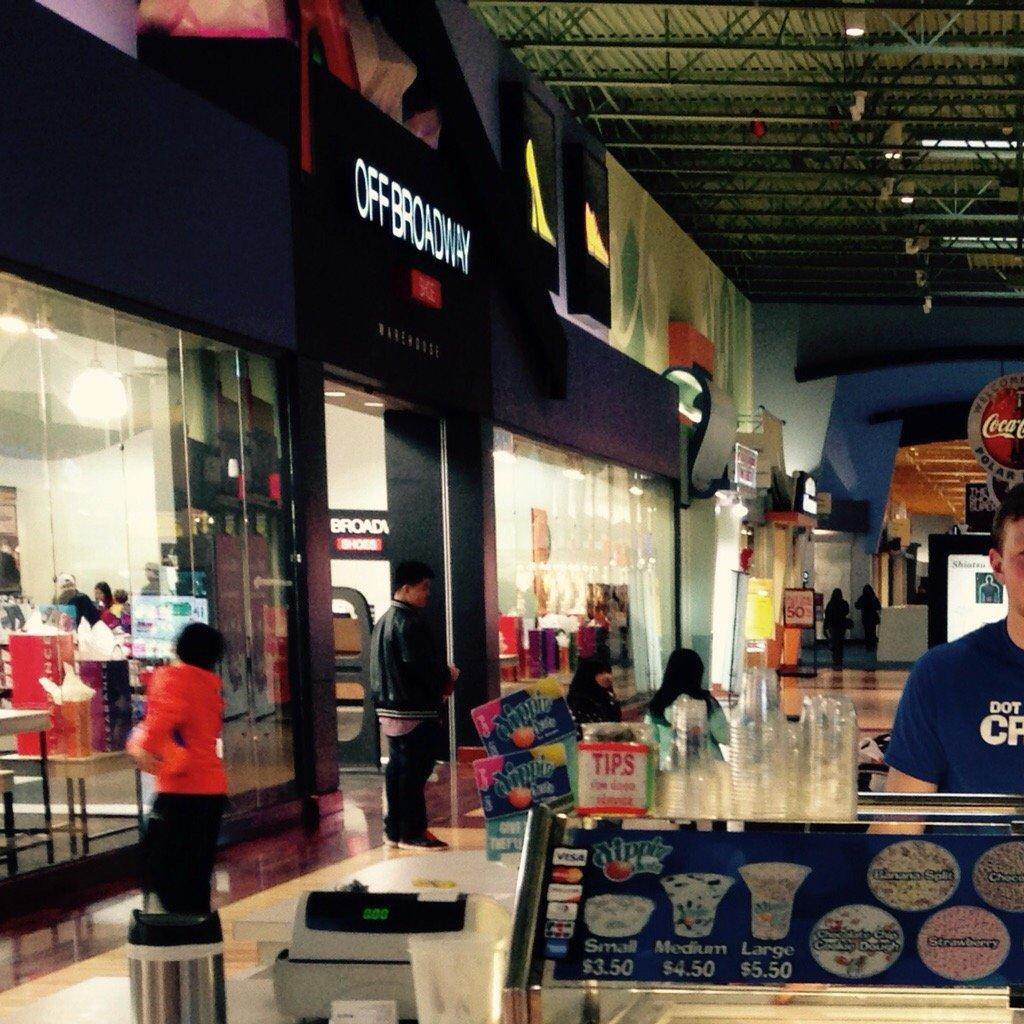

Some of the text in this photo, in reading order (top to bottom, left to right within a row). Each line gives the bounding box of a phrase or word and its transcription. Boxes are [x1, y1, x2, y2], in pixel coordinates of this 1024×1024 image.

[355, 158, 471, 275] OFF BROADWAY
[378, 322, 440, 359] WAREHOUSE
[975, 445, 1015, 480] POLAR
[989, 701, 1022, 715] DOT
[592, 752, 635, 776] TIPS
[556, 852, 585, 862] VISA
[872, 867, 954, 882] Banana Split
[584, 939, 639, 954] Small
[654, 940, 727, 955] Medium
[741, 941, 795, 959] Large
[860, 940, 899, 953] Dough
[927, 936, 1000, 949] Strawberry
[582, 958, 634, 977] $3.50
[663, 959, 716, 978] $4.50
[741, 960, 792, 979] $5.50
